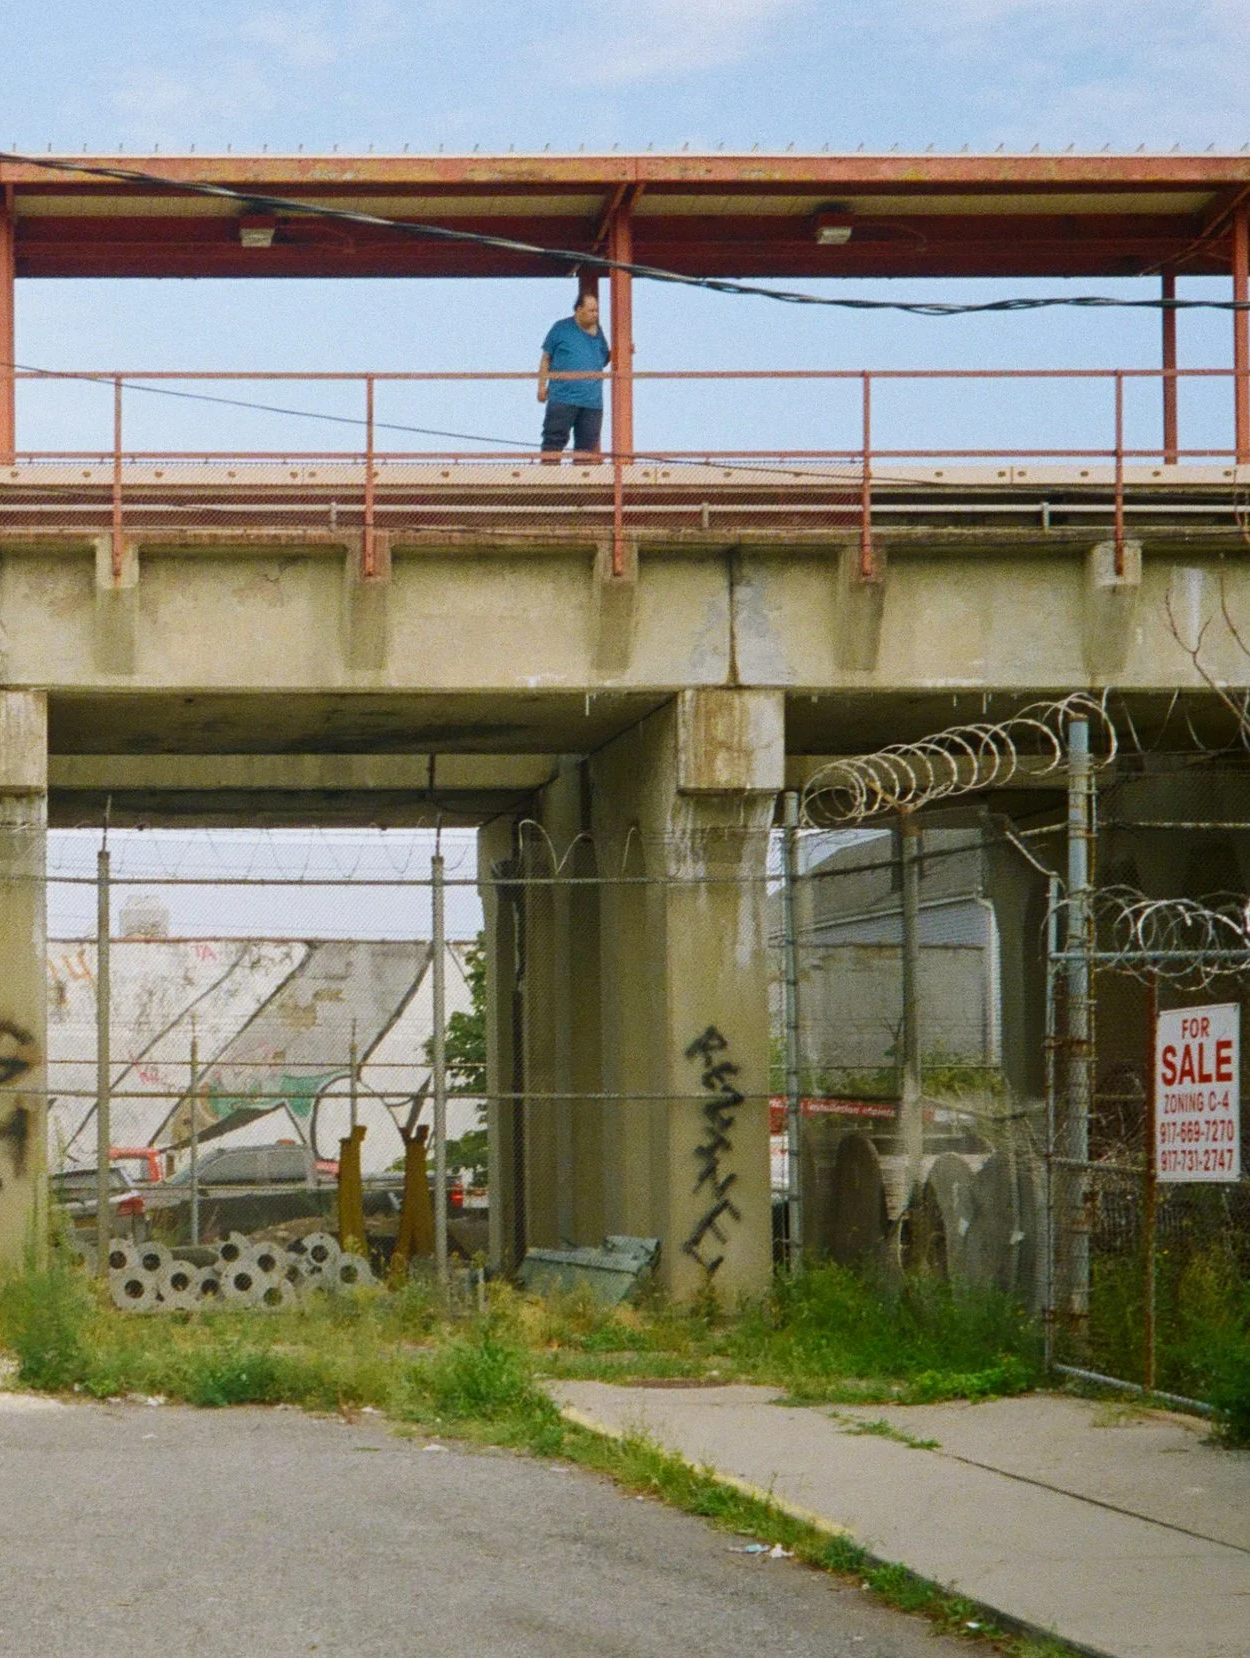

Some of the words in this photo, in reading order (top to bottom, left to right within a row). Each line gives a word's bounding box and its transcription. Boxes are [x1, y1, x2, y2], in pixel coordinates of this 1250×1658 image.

[1181, 1017, 1210, 1038] FOR
[1161, 1040, 1233, 1086] SALE
[1164, 1092, 1204, 1114] ZONING
[1208, 1091, 1230, 1112] C-4
[1160, 1120, 1234, 1143] 917-669-7270
[1161, 1148, 1234, 1172] 917-731-2747
